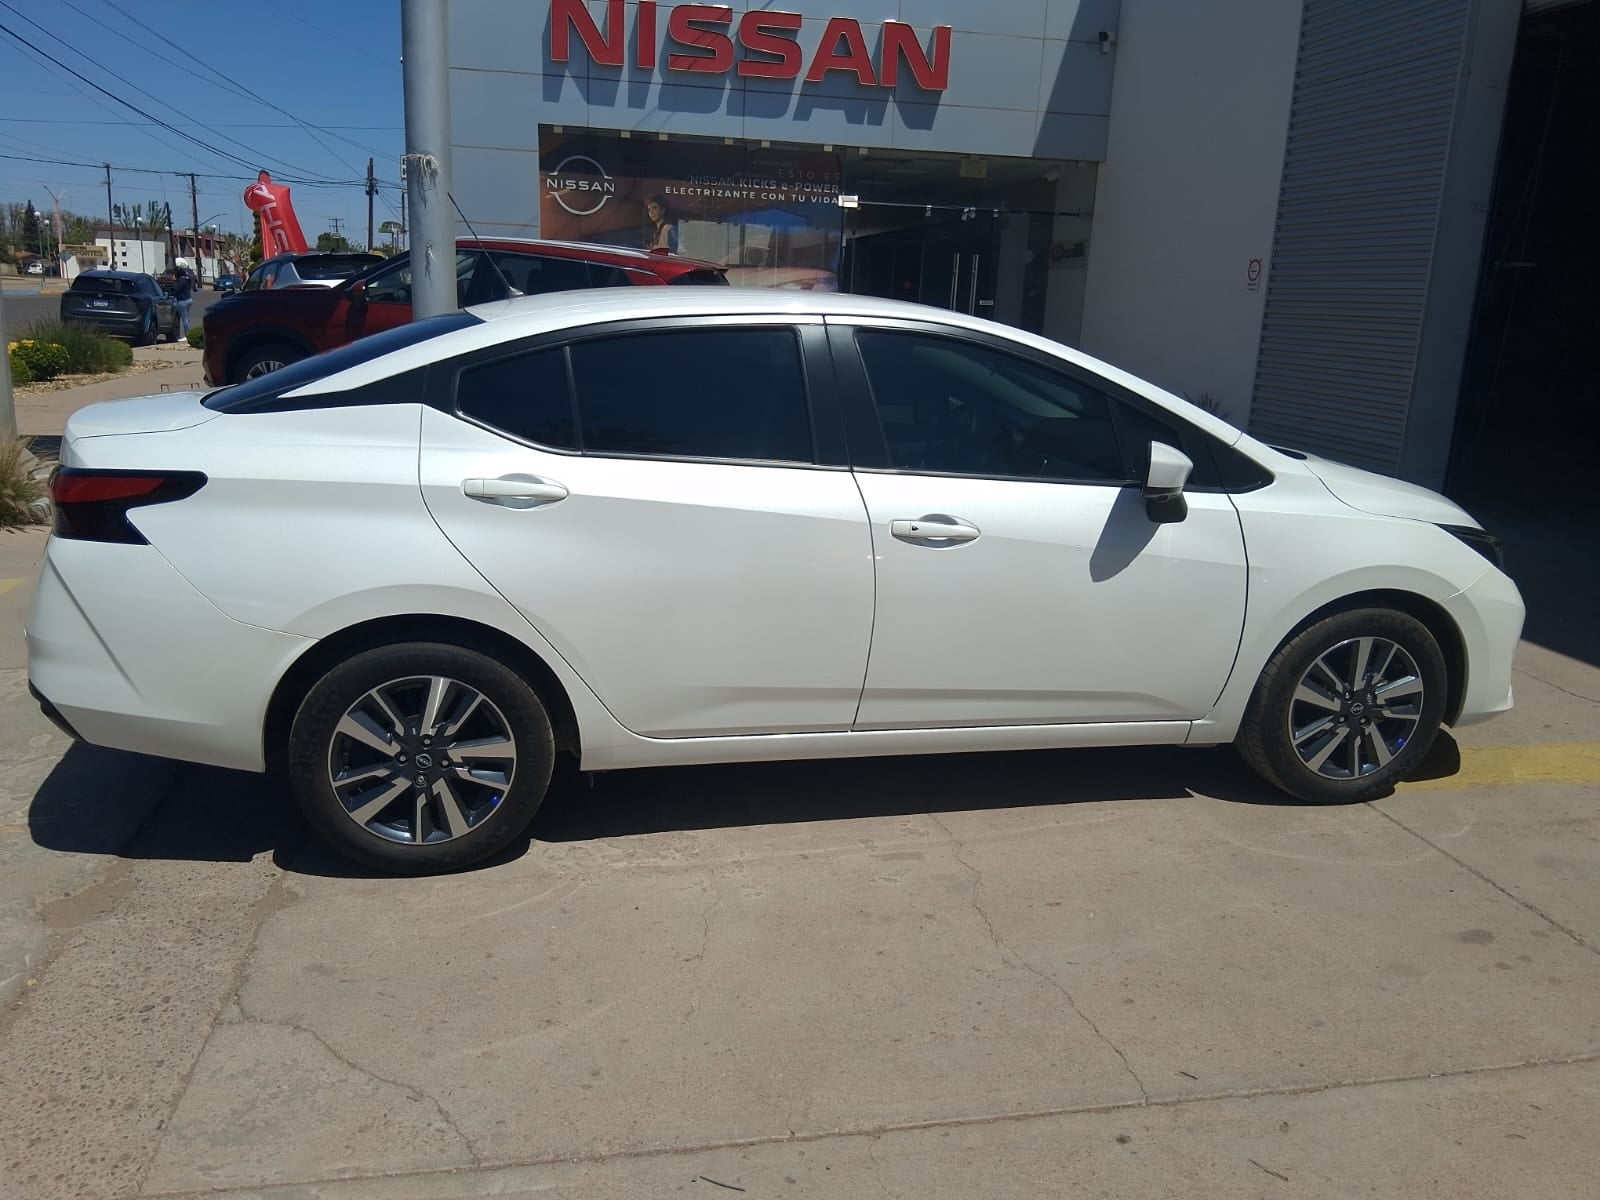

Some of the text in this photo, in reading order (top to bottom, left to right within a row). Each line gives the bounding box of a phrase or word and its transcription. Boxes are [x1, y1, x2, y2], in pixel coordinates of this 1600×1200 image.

[551, 0, 952, 91] NISSAN
[546, 178, 616, 193] NISSAN
[690, 175, 735, 187] NISSAN
[740, 178, 777, 190] KICKS
[665, 186, 756, 199] ELECTRIZANTE
[761, 192, 785, 201] CON
[791, 194, 806, 203] TU
